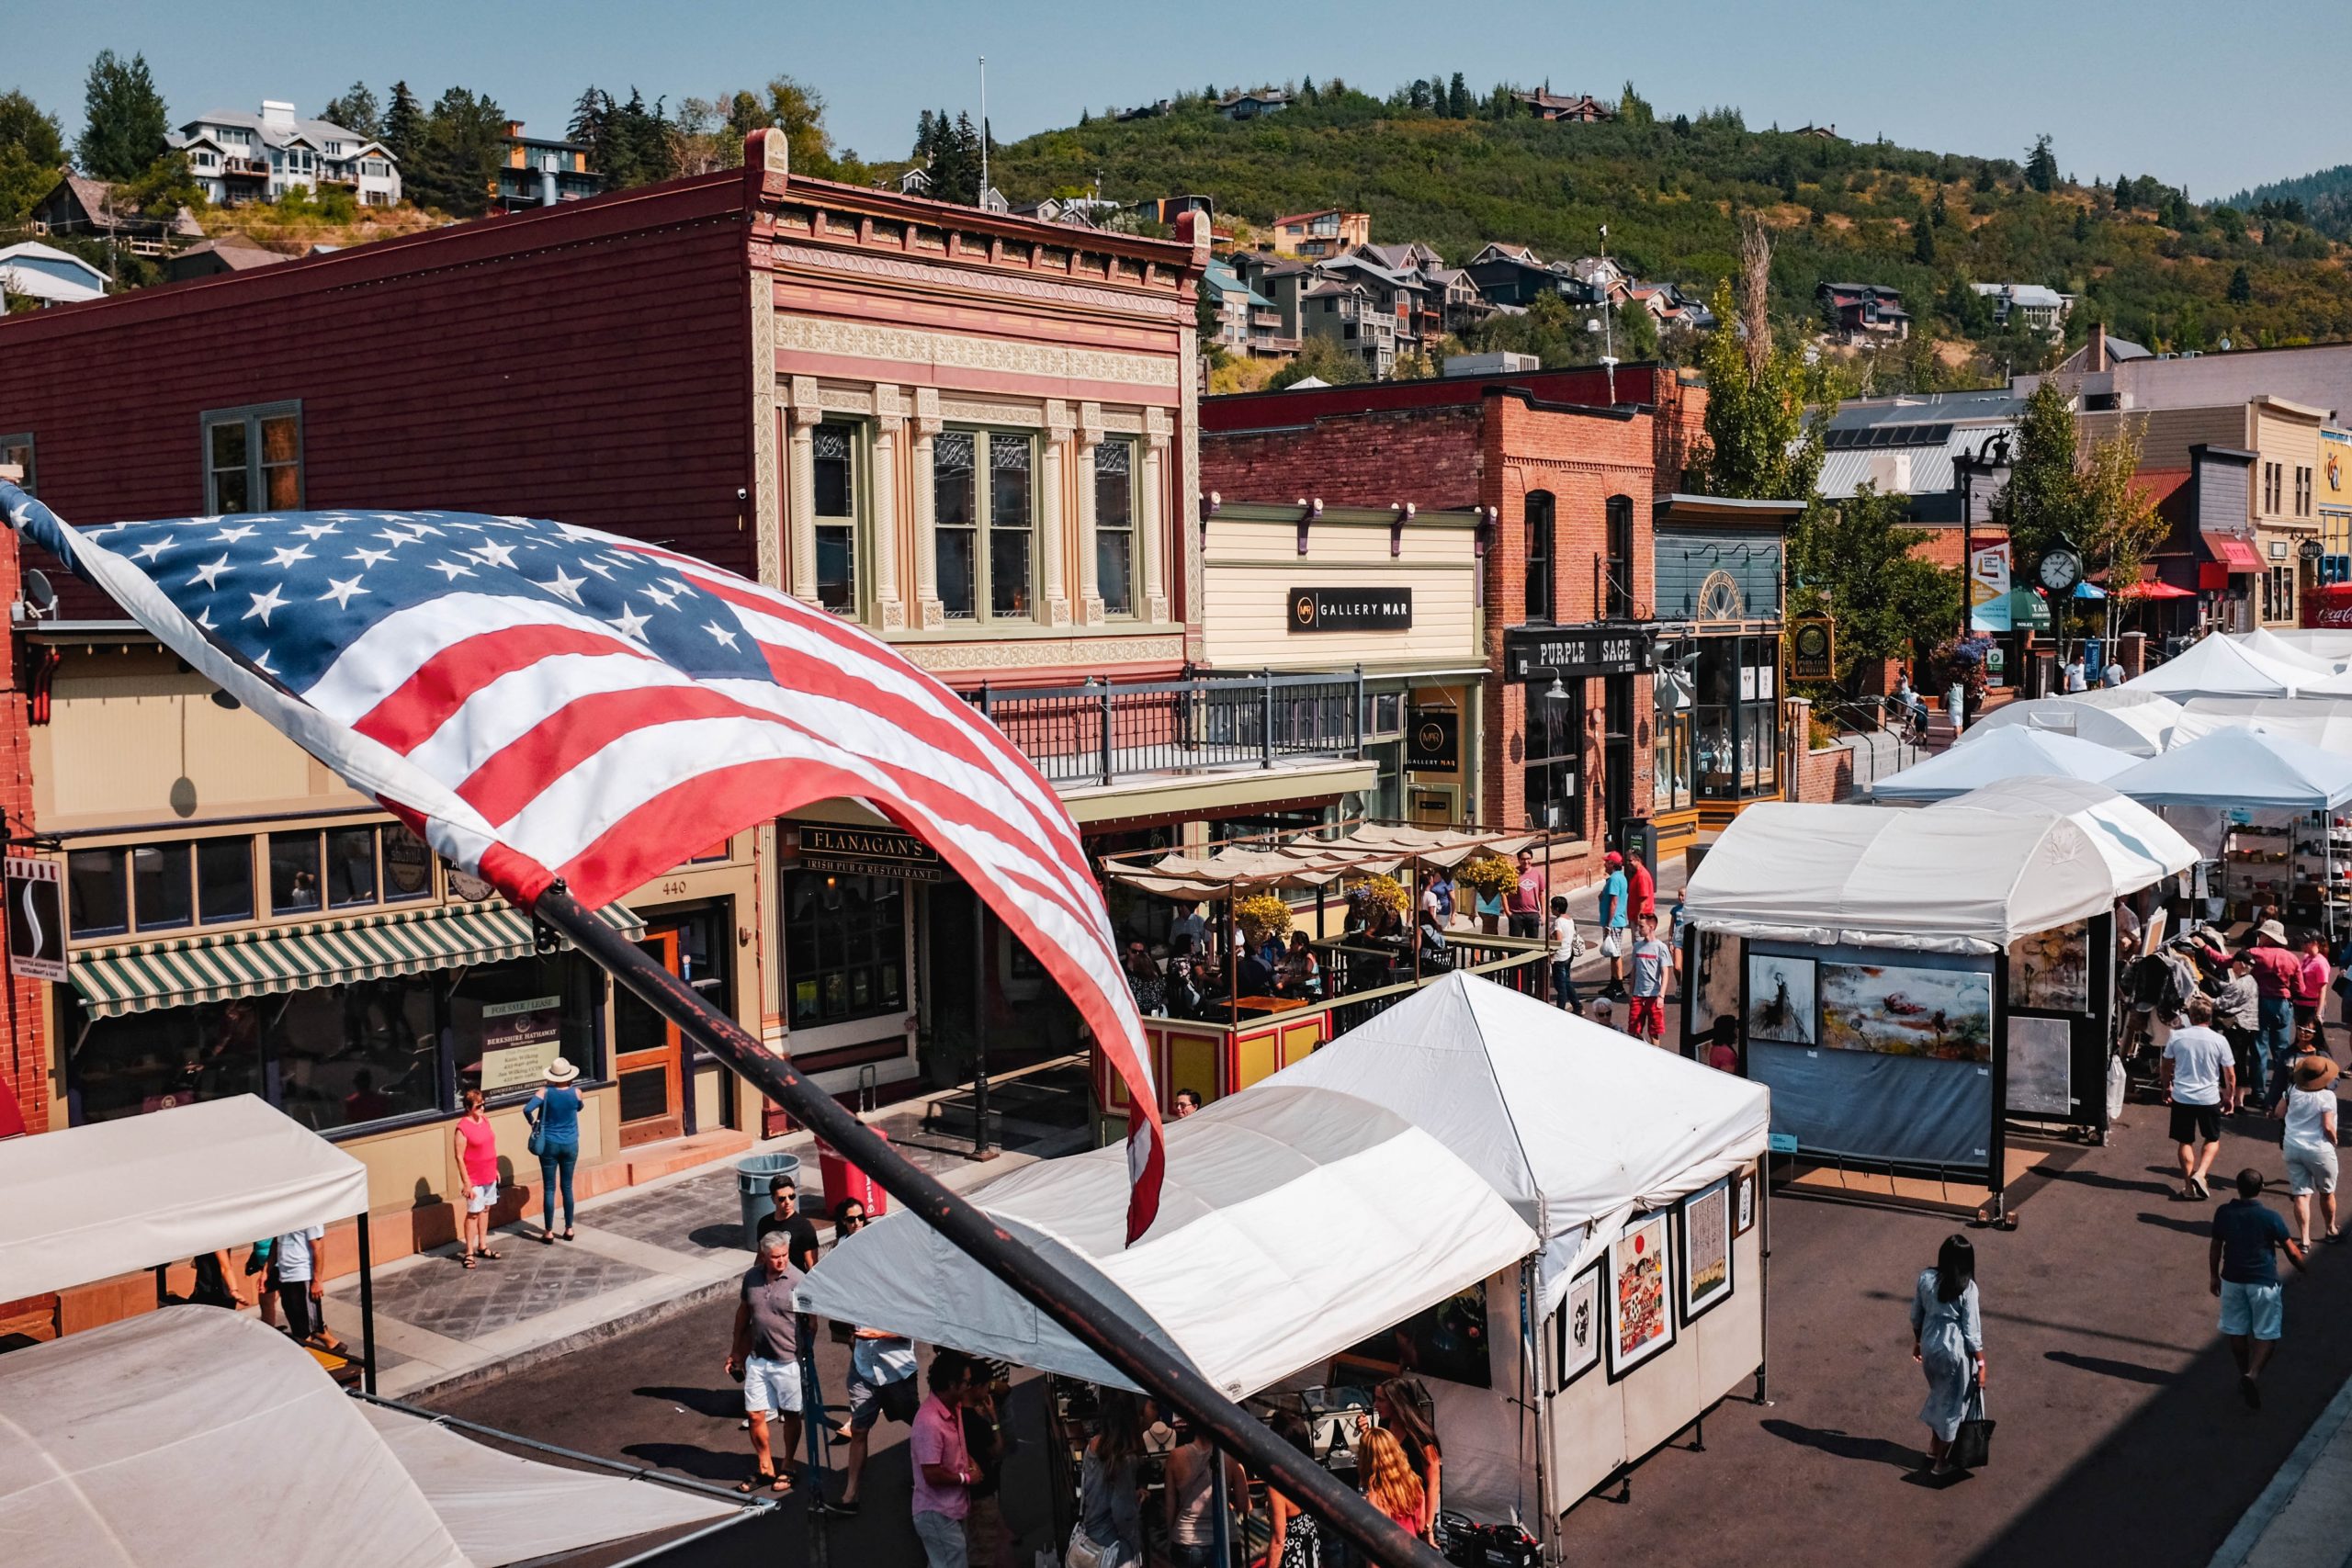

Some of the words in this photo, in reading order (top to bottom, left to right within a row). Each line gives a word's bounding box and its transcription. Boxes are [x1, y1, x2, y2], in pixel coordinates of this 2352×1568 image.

[2299, 545, 2324, 554] ROOTS
[1320, 604, 1378, 615] GALLERY
[1382, 603, 1408, 615] MAR
[1540, 641, 1585, 666] PURPLE
[1602, 639, 1631, 661] SAGE
[814, 831, 923, 856] FLANAGAN'S
[808, 860, 834, 872] IRISH
[836, 861, 854, 872] PUB
[867, 864, 933, 879] RESTAURANT
[662, 881, 686, 895] 440
[491, 1006, 507, 1015] FOR
[507, 1002, 526, 1012] SALE
[531, 998, 553, 1010] LEASE
[487, 1033, 524, 1045] BERKSHIRE
[525, 1029, 557, 1040] HATHAWAY
[490, 1084, 524, 1095] COMMERCIAL
